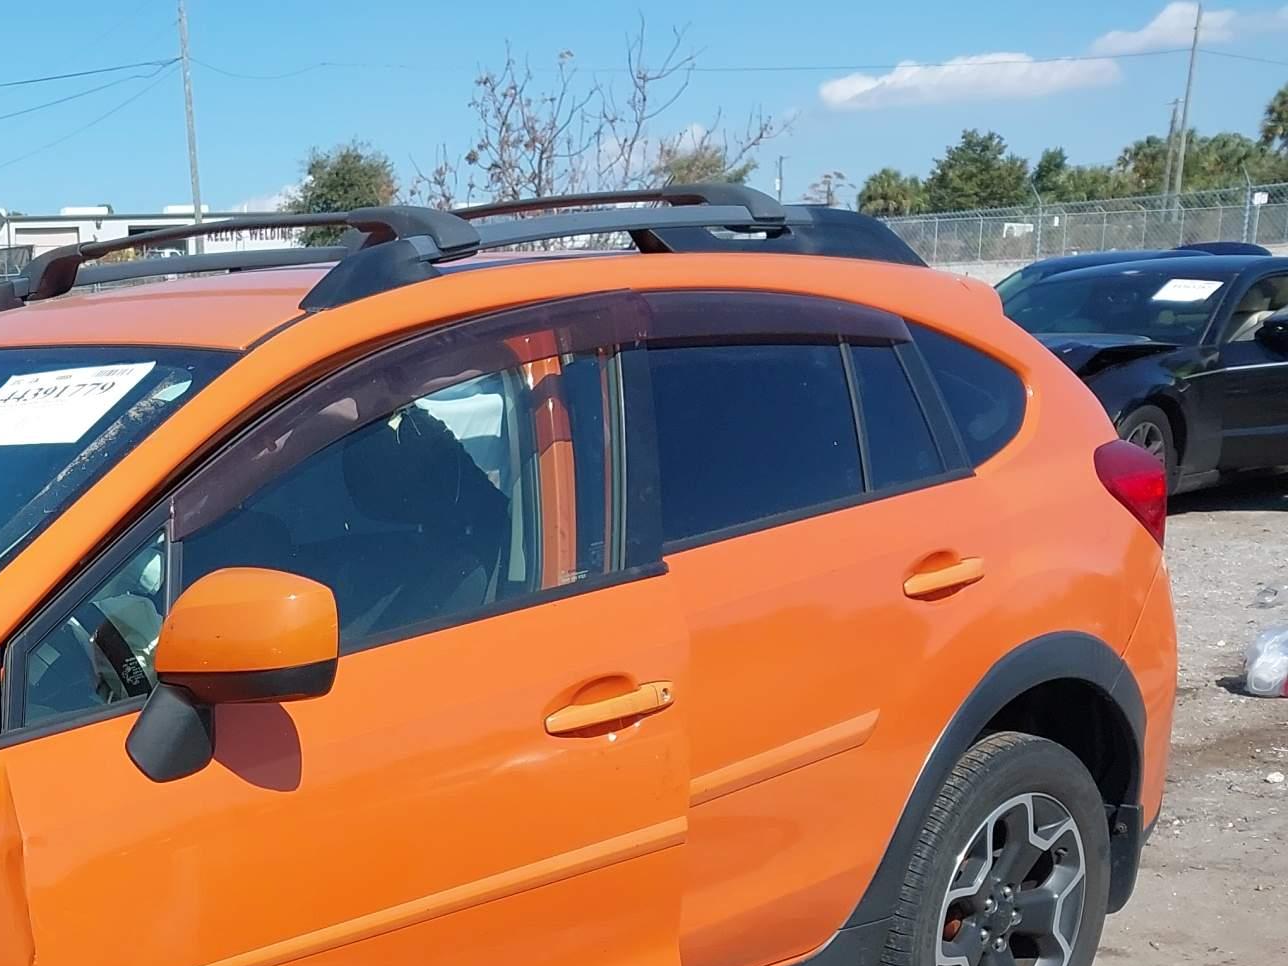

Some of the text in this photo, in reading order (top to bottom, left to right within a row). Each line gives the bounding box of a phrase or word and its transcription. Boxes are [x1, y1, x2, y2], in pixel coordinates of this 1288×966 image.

[207, 226, 293, 242] KELLYS WELDING
[0, 381, 116, 403] 44391779
